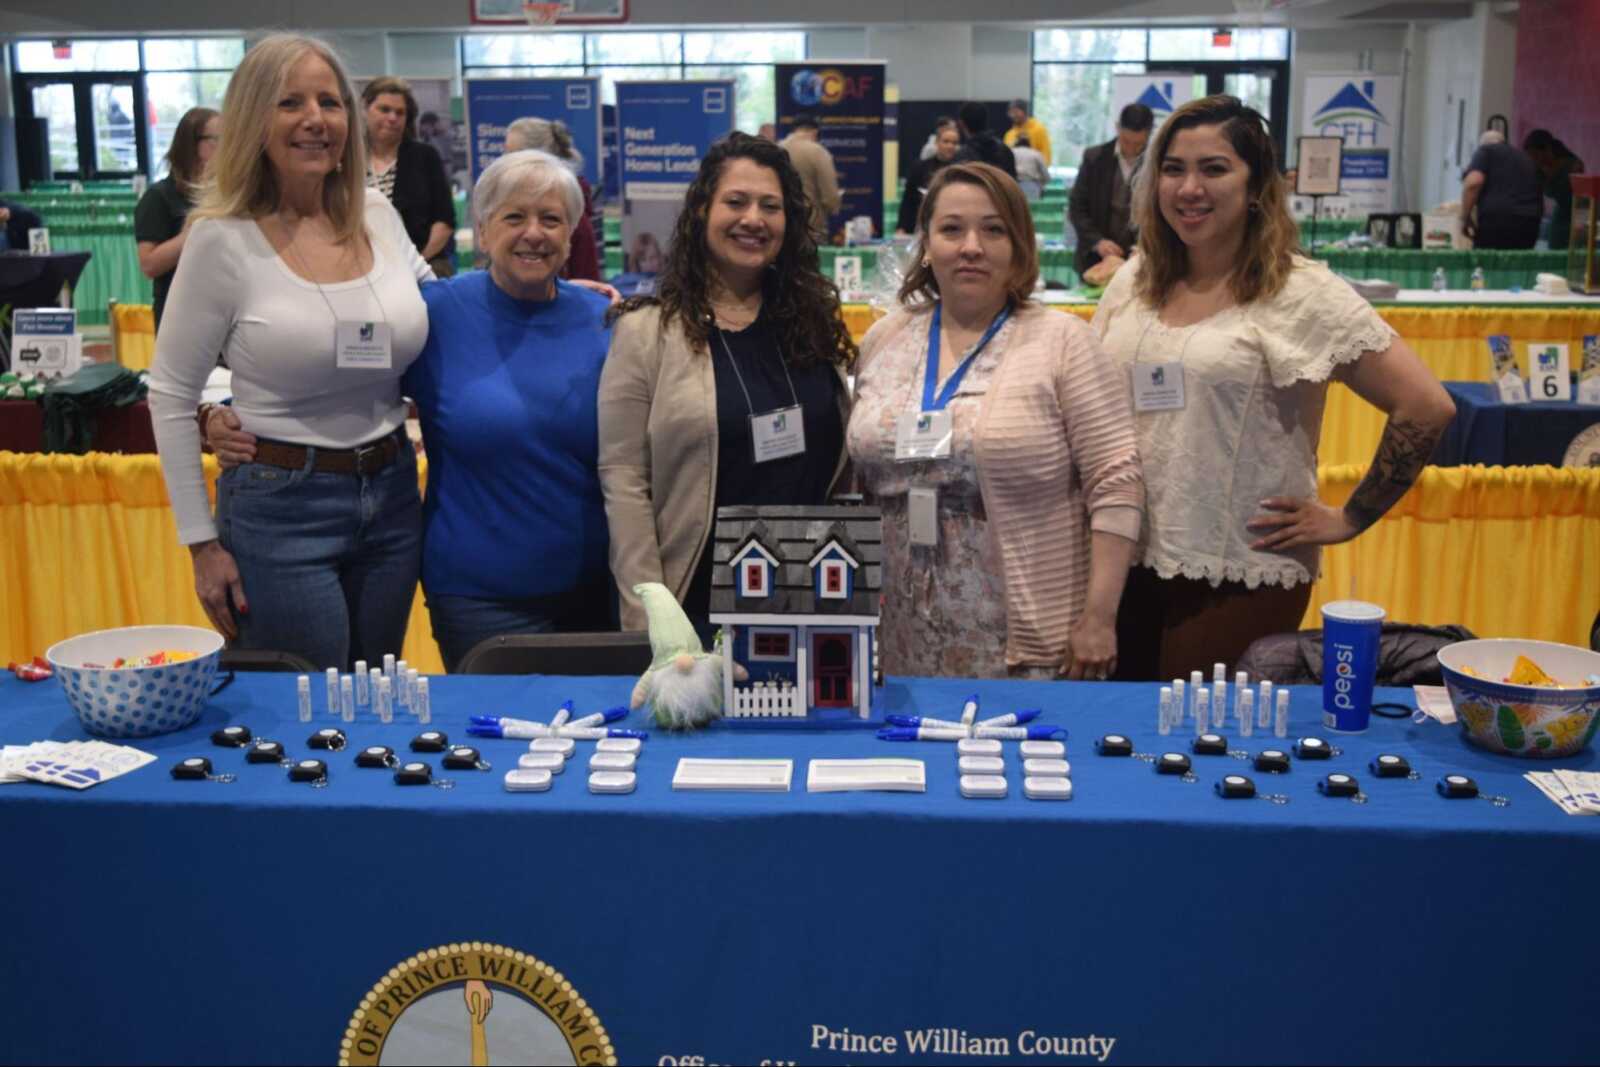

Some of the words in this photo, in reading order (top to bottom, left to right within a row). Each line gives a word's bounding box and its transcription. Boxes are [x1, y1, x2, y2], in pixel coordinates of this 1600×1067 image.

[624, 126, 655, 141] Next
[625, 142, 698, 157] Generation
[625, 158, 662, 172] Home
[1543, 375, 1558, 397] 6
[1333, 643, 1356, 709] pepsi
[356, 1019, 383, 1057] OF
[374, 956, 468, 1020] PRINCE
[478, 954, 590, 1039] WILLIAM
[810, 1024, 897, 1054] Prince
[904, 1028, 1010, 1056] William
[1017, 1030, 1116, 1062] County
